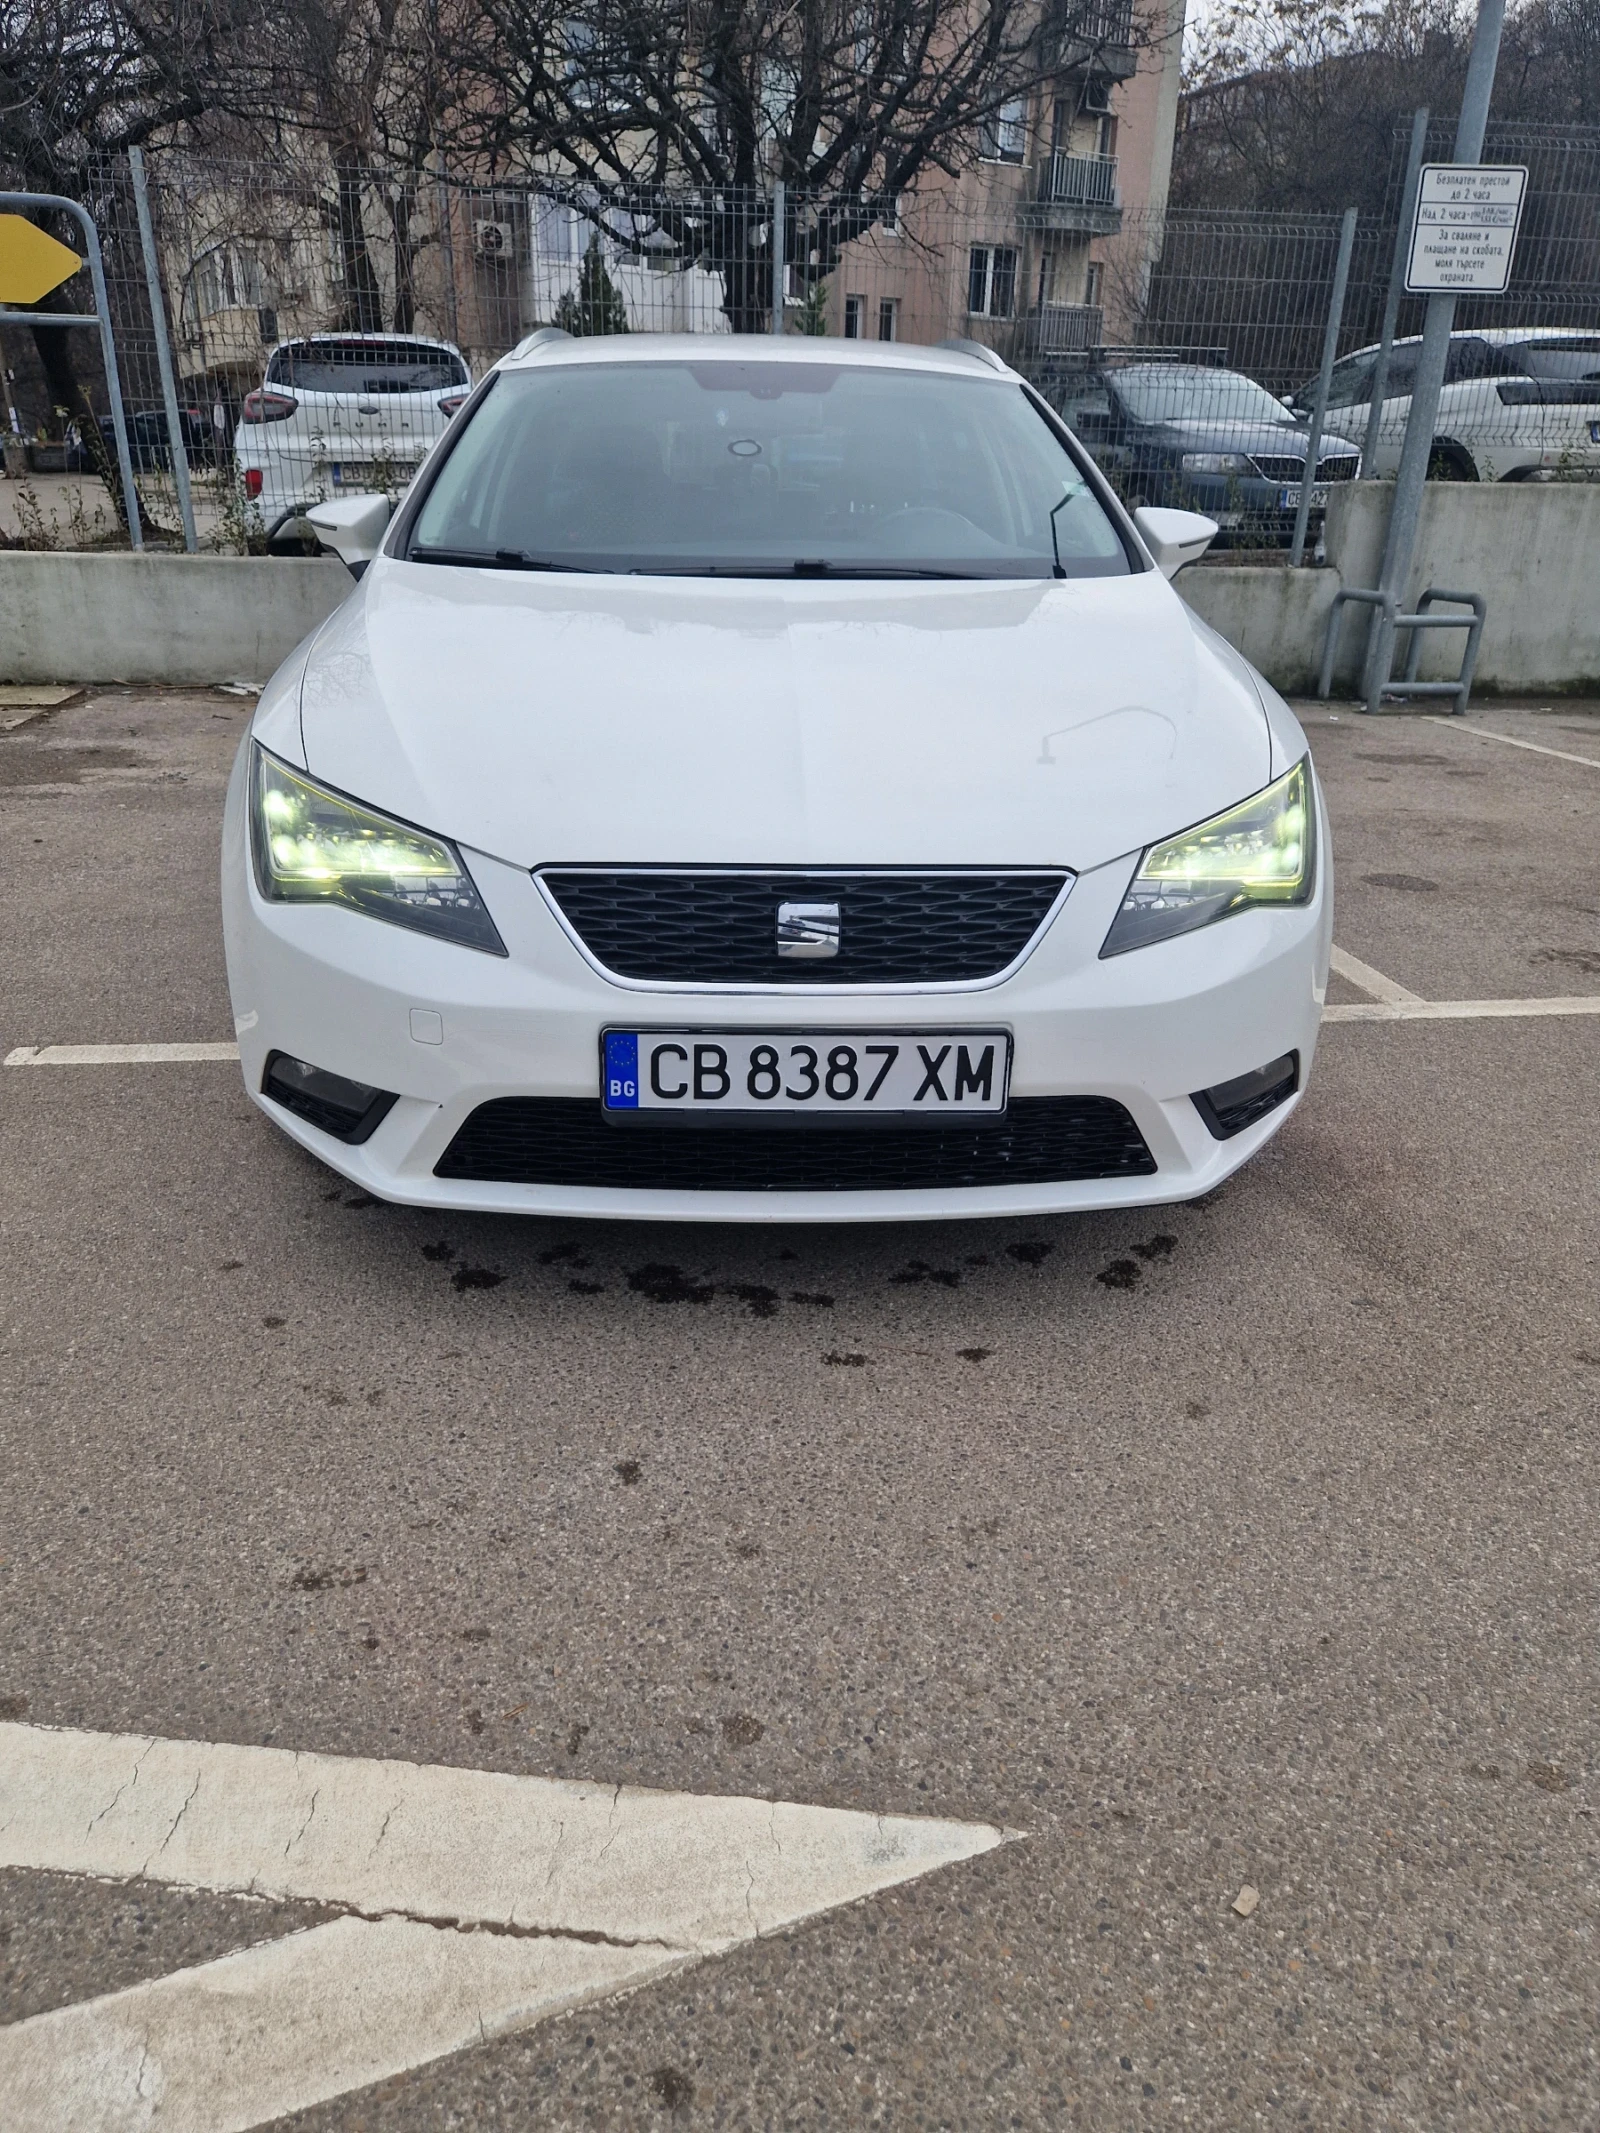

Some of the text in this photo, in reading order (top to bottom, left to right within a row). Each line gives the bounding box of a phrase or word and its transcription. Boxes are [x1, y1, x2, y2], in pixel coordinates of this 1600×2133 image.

[1436, 173, 1511, 188] Безплатен престой
[1450, 190, 1461, 200] до
[1464, 188, 1471, 200] 2
[1421, 208, 1436, 220] Над
[1440, 208, 1446, 219] 2
[1439, 229, 1449, 240] За
[1451, 231, 1482, 241] сваляне
[1423, 245, 1457, 255] плащане
[1460, 247, 1470, 255] на
[1434, 260, 1485, 271] моля търсете
[610, 1043, 995, 1101] BG CB 8387 XM
